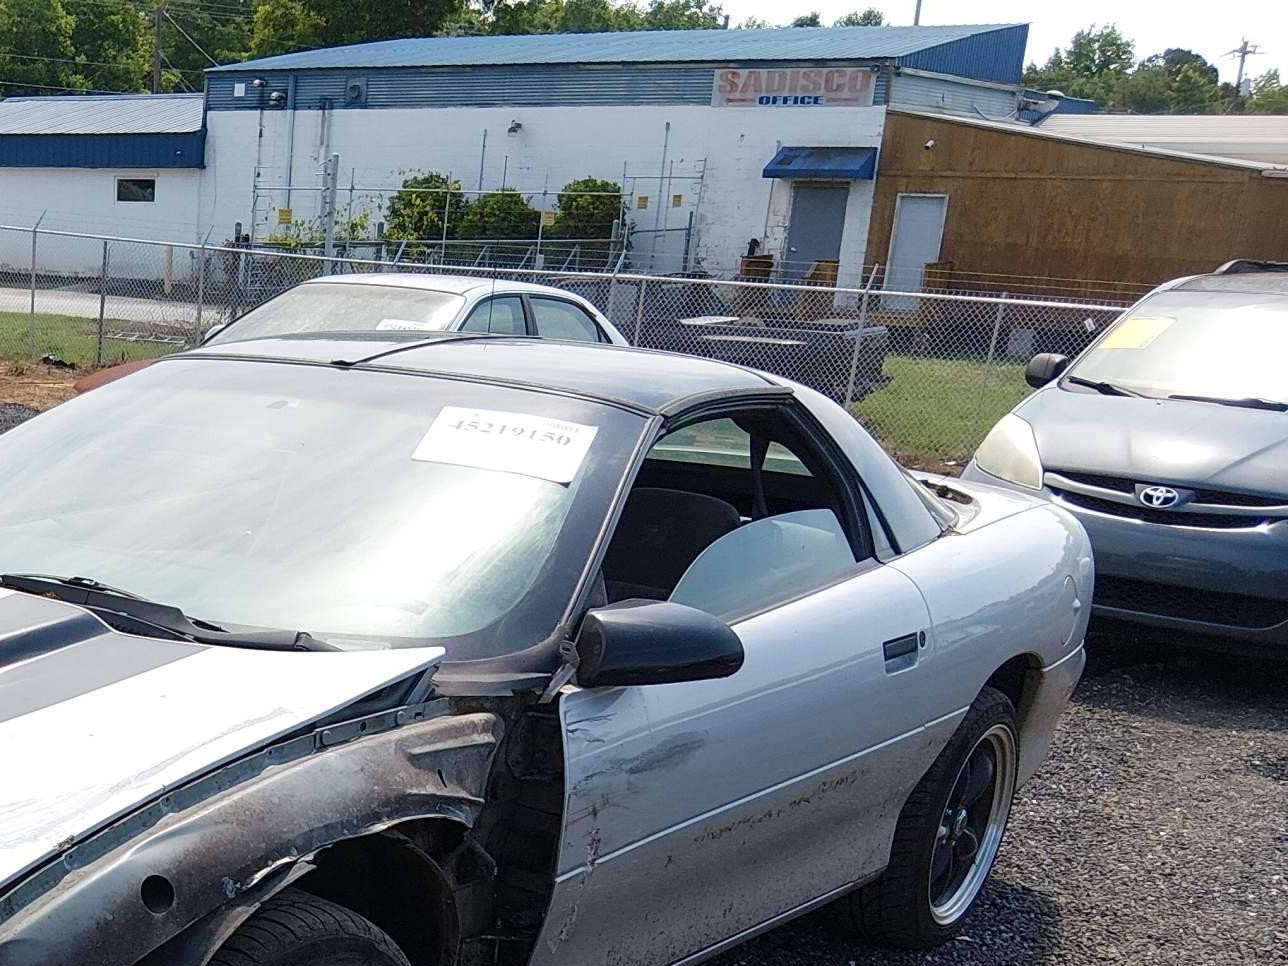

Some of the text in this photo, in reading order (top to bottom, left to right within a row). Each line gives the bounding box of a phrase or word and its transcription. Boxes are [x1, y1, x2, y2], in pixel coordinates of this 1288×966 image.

[718, 70, 873, 94] SADISCO
[758, 95, 825, 105] OFFICE
[448, 419, 572, 447] 45219150
